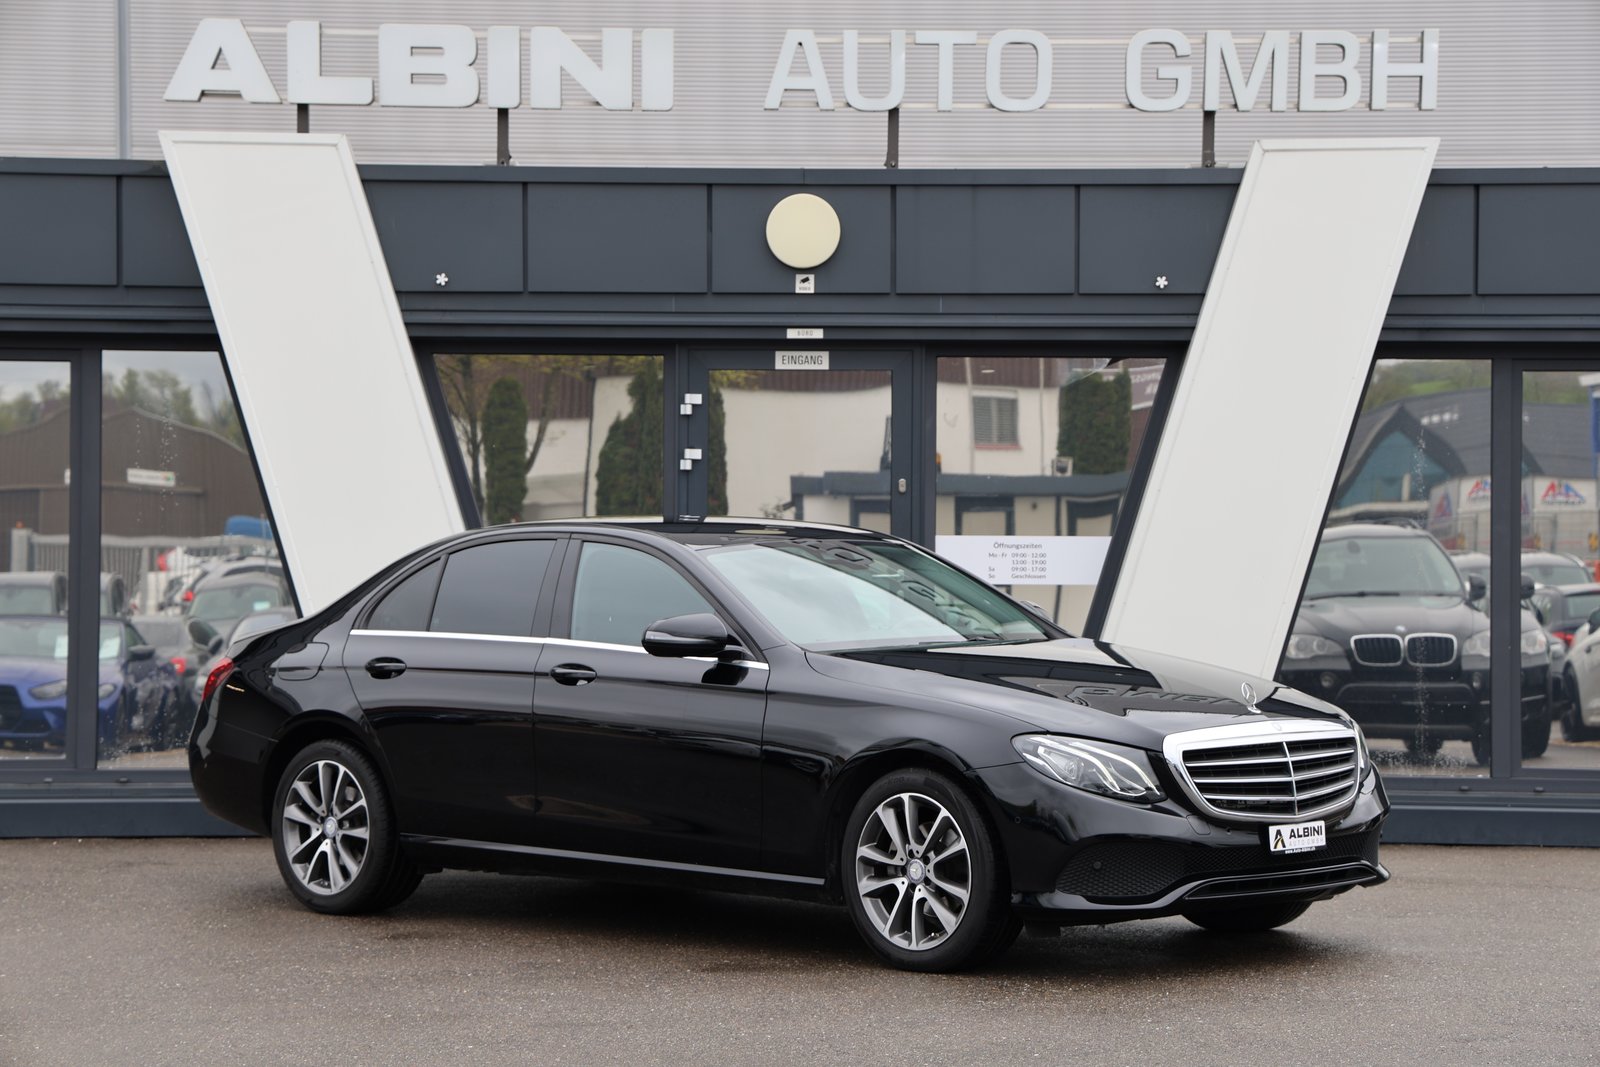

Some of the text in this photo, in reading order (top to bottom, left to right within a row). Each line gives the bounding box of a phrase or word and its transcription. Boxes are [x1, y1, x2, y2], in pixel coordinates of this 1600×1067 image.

[163, 18, 1440, 112] ALBINI AUTO GMBH
[781, 354, 823, 365] EINGANG
[993, 542, 1043, 550] Öffnungszeiten
[1289, 825, 1323, 839] ALBINI
